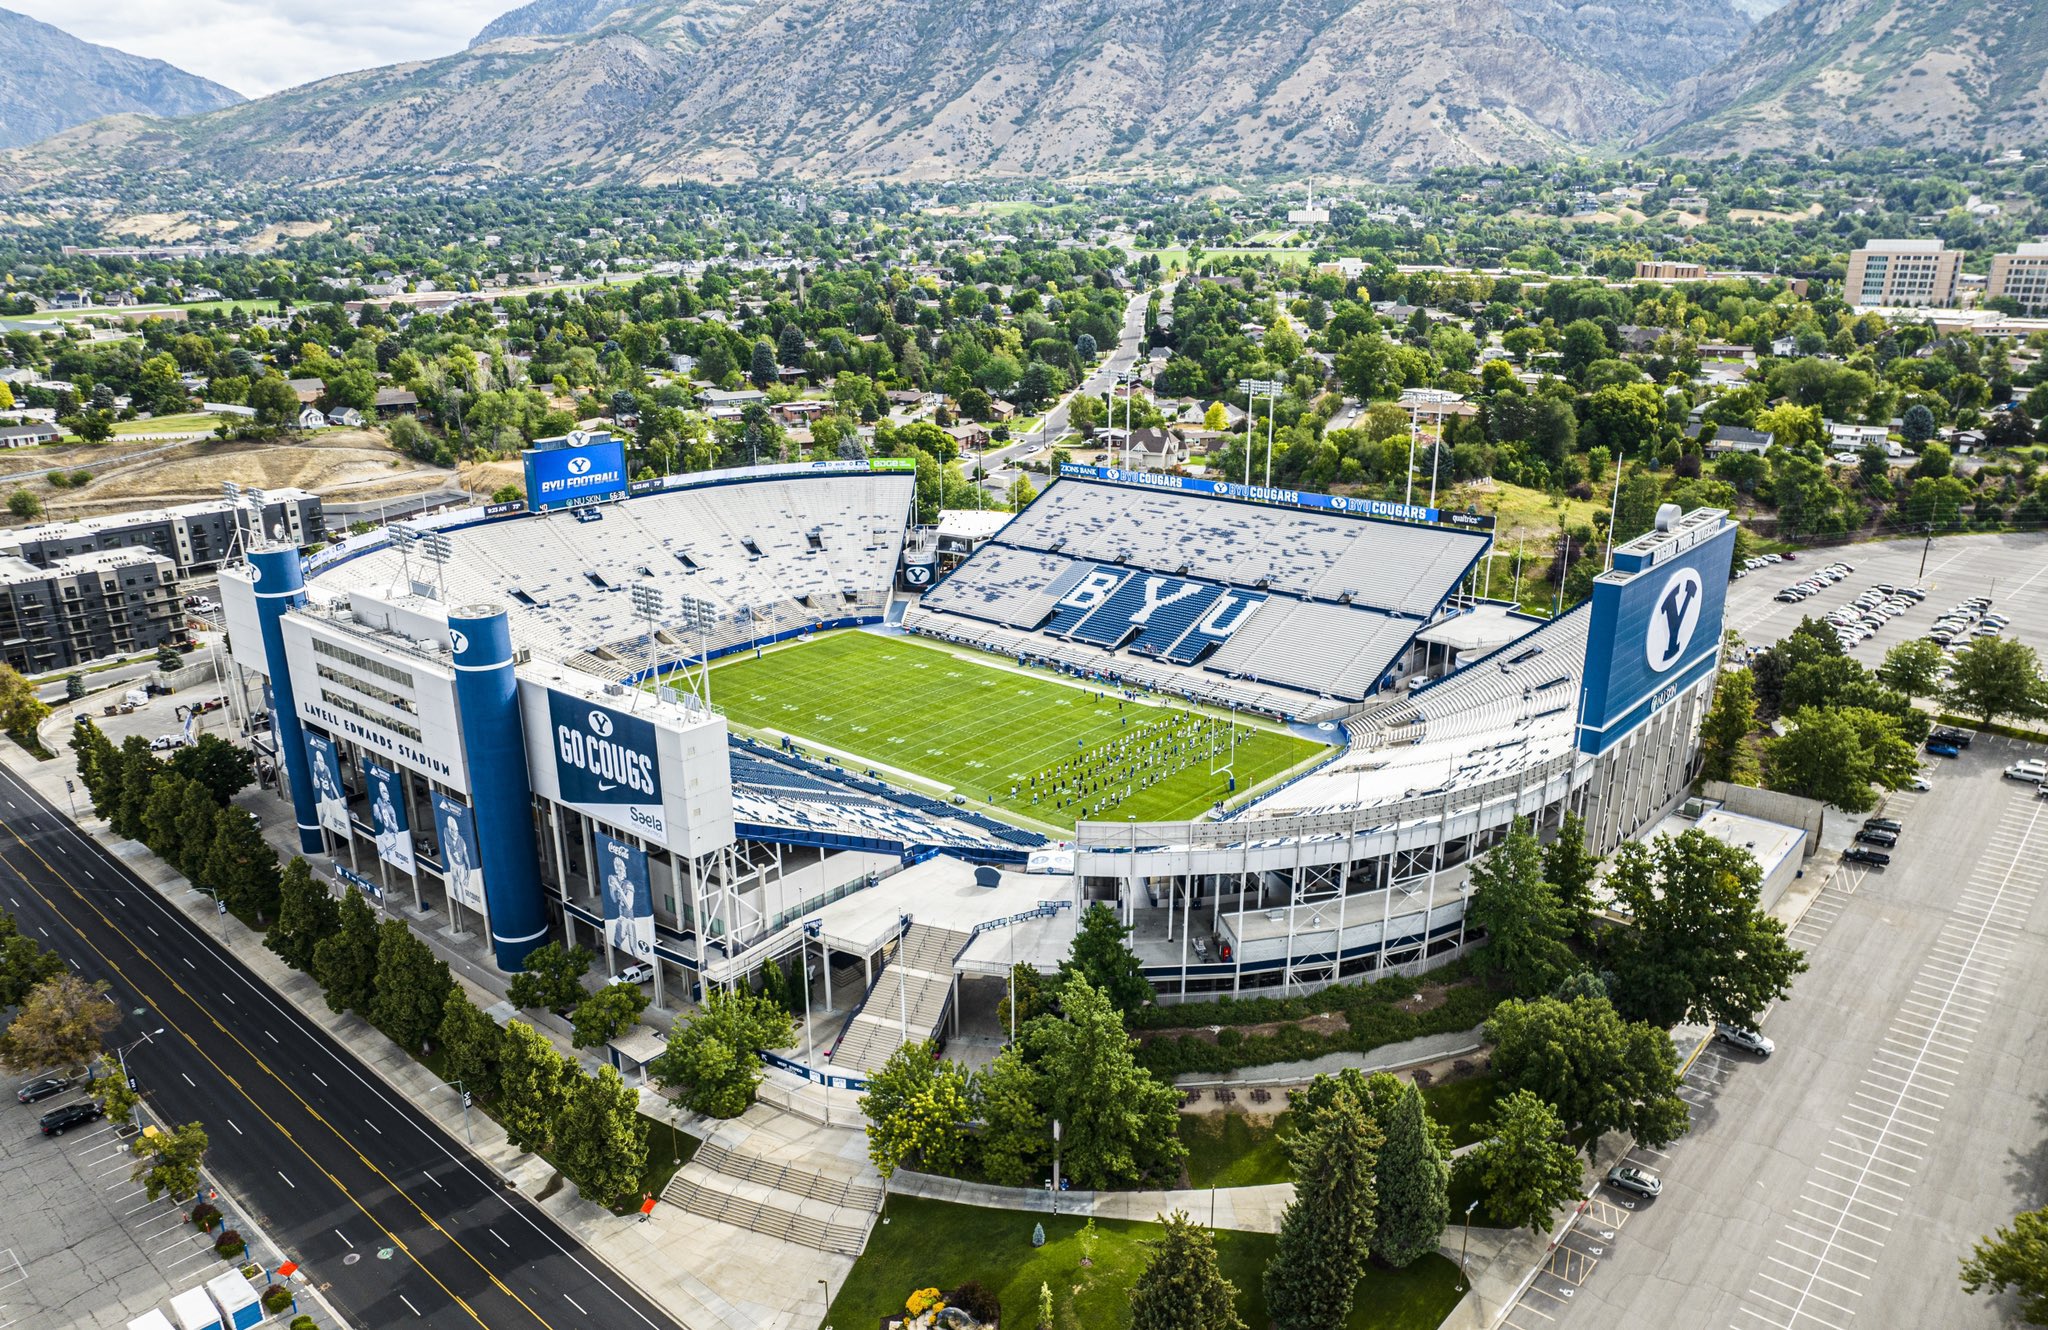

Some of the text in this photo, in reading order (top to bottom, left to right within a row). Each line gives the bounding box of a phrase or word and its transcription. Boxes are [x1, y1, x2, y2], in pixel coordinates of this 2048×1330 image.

[1060, 464, 1098, 476] ZIONS BANK
[1120, 470, 1138, 482] BYU
[1139, 472, 1183, 488] COUGARS
[541, 471, 620, 493] BYU FOOTBALL
[1228, 484, 1250, 496] BYU
[1251, 487, 1299, 503] COUGARS
[1348, 498, 1371, 513] BYU
[1372, 503, 1427, 520] COUGARS
[344, 719, 393, 750] EDWARDS
[399, 744, 451, 776] STADIUM
[558, 725, 655, 796] GO COUGS
[630, 806, 663, 832] Saela
